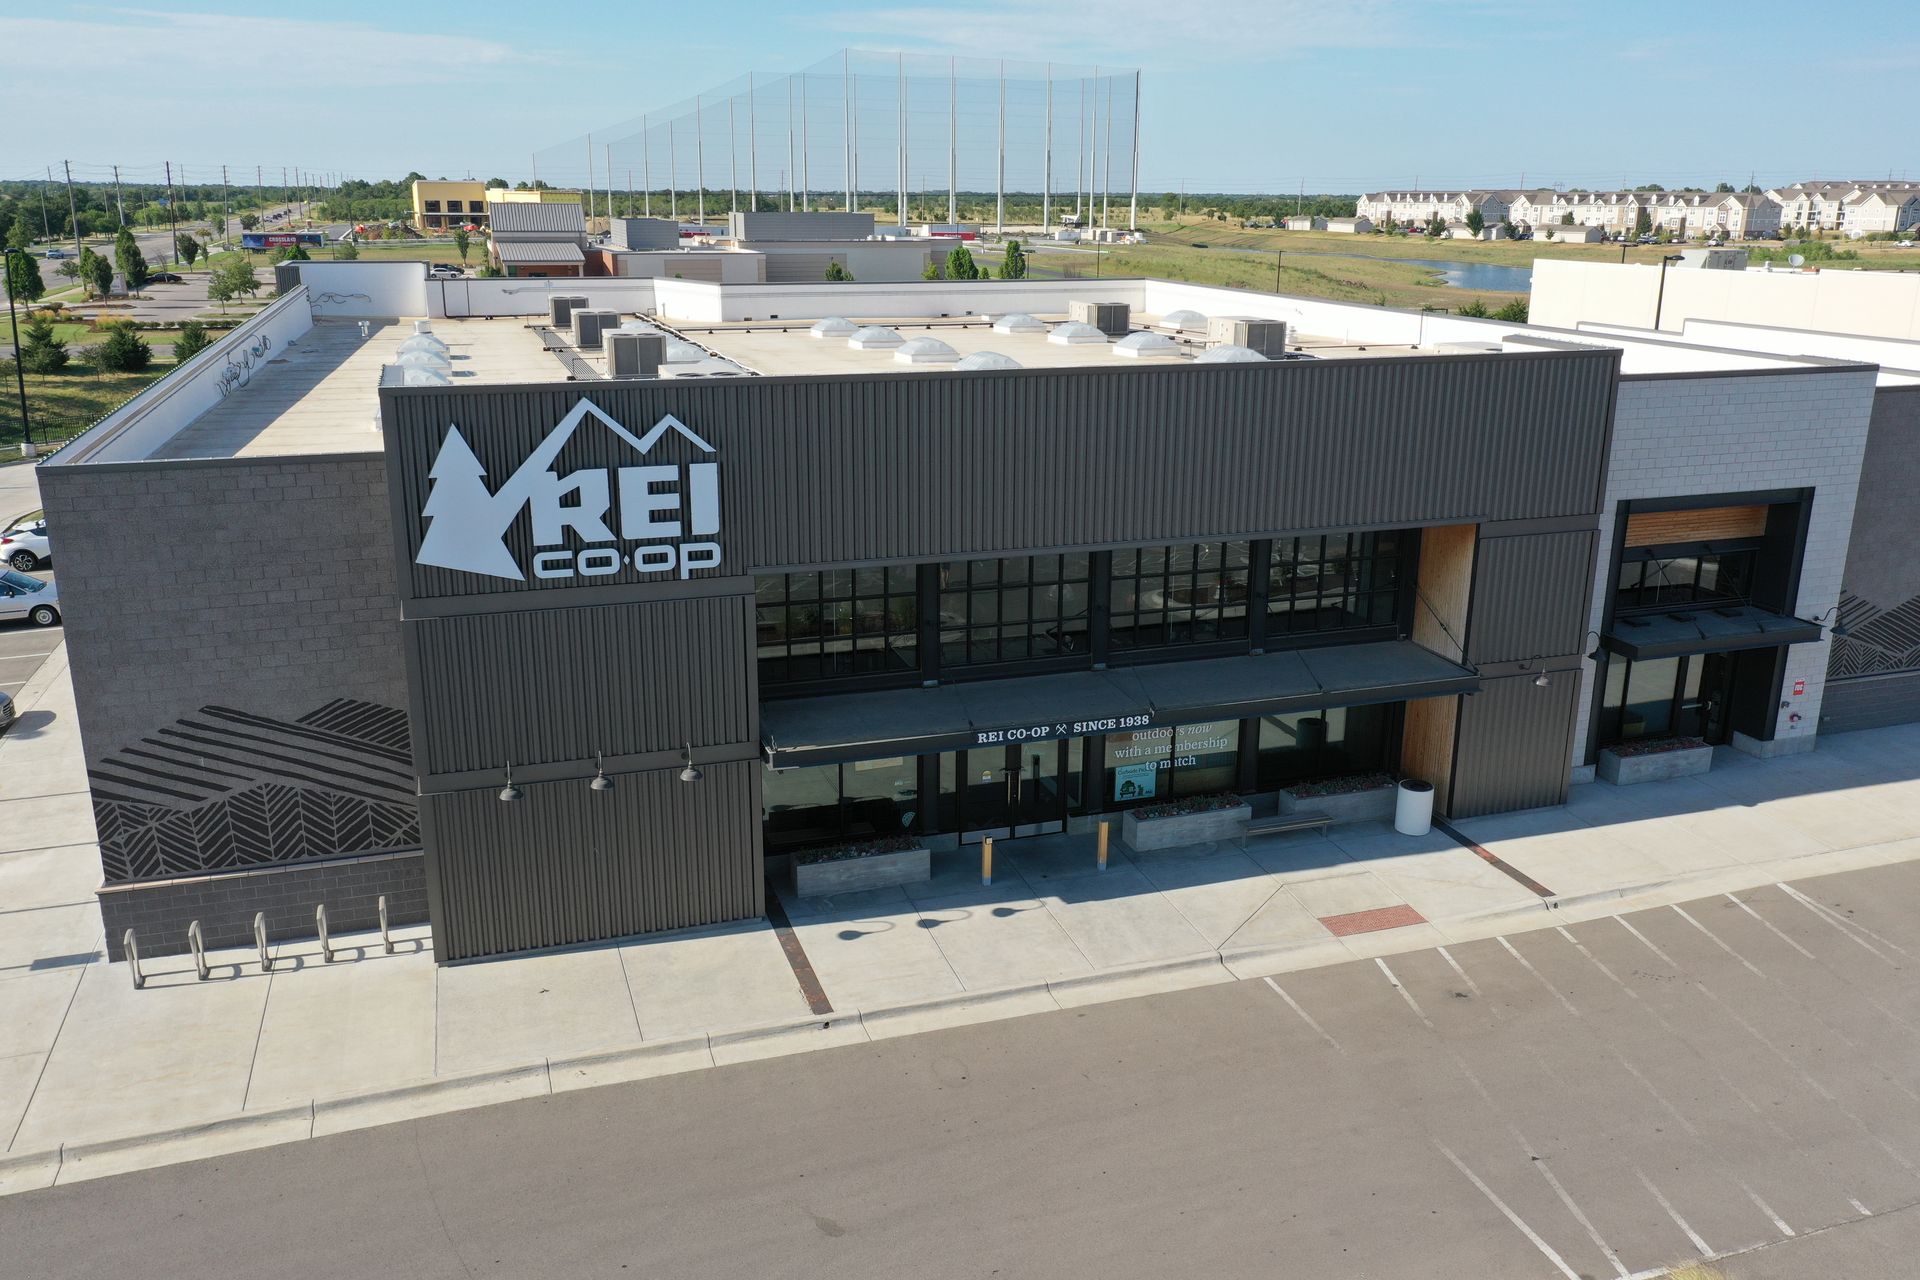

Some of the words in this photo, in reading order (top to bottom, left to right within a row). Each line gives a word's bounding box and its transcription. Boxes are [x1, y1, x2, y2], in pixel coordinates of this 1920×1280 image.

[530, 462, 720, 547] REI
[977, 731, 1004, 744] REI
[1007, 726, 1050, 740] CO-OP
[1073, 718, 1116, 733] SINCE
[1119, 714, 1149, 728] 1938
[1187, 724, 1212, 735] now
[1115, 745, 1141, 758] with
[1144, 747, 1151, 755] a
[1145, 761, 1157, 771] to
